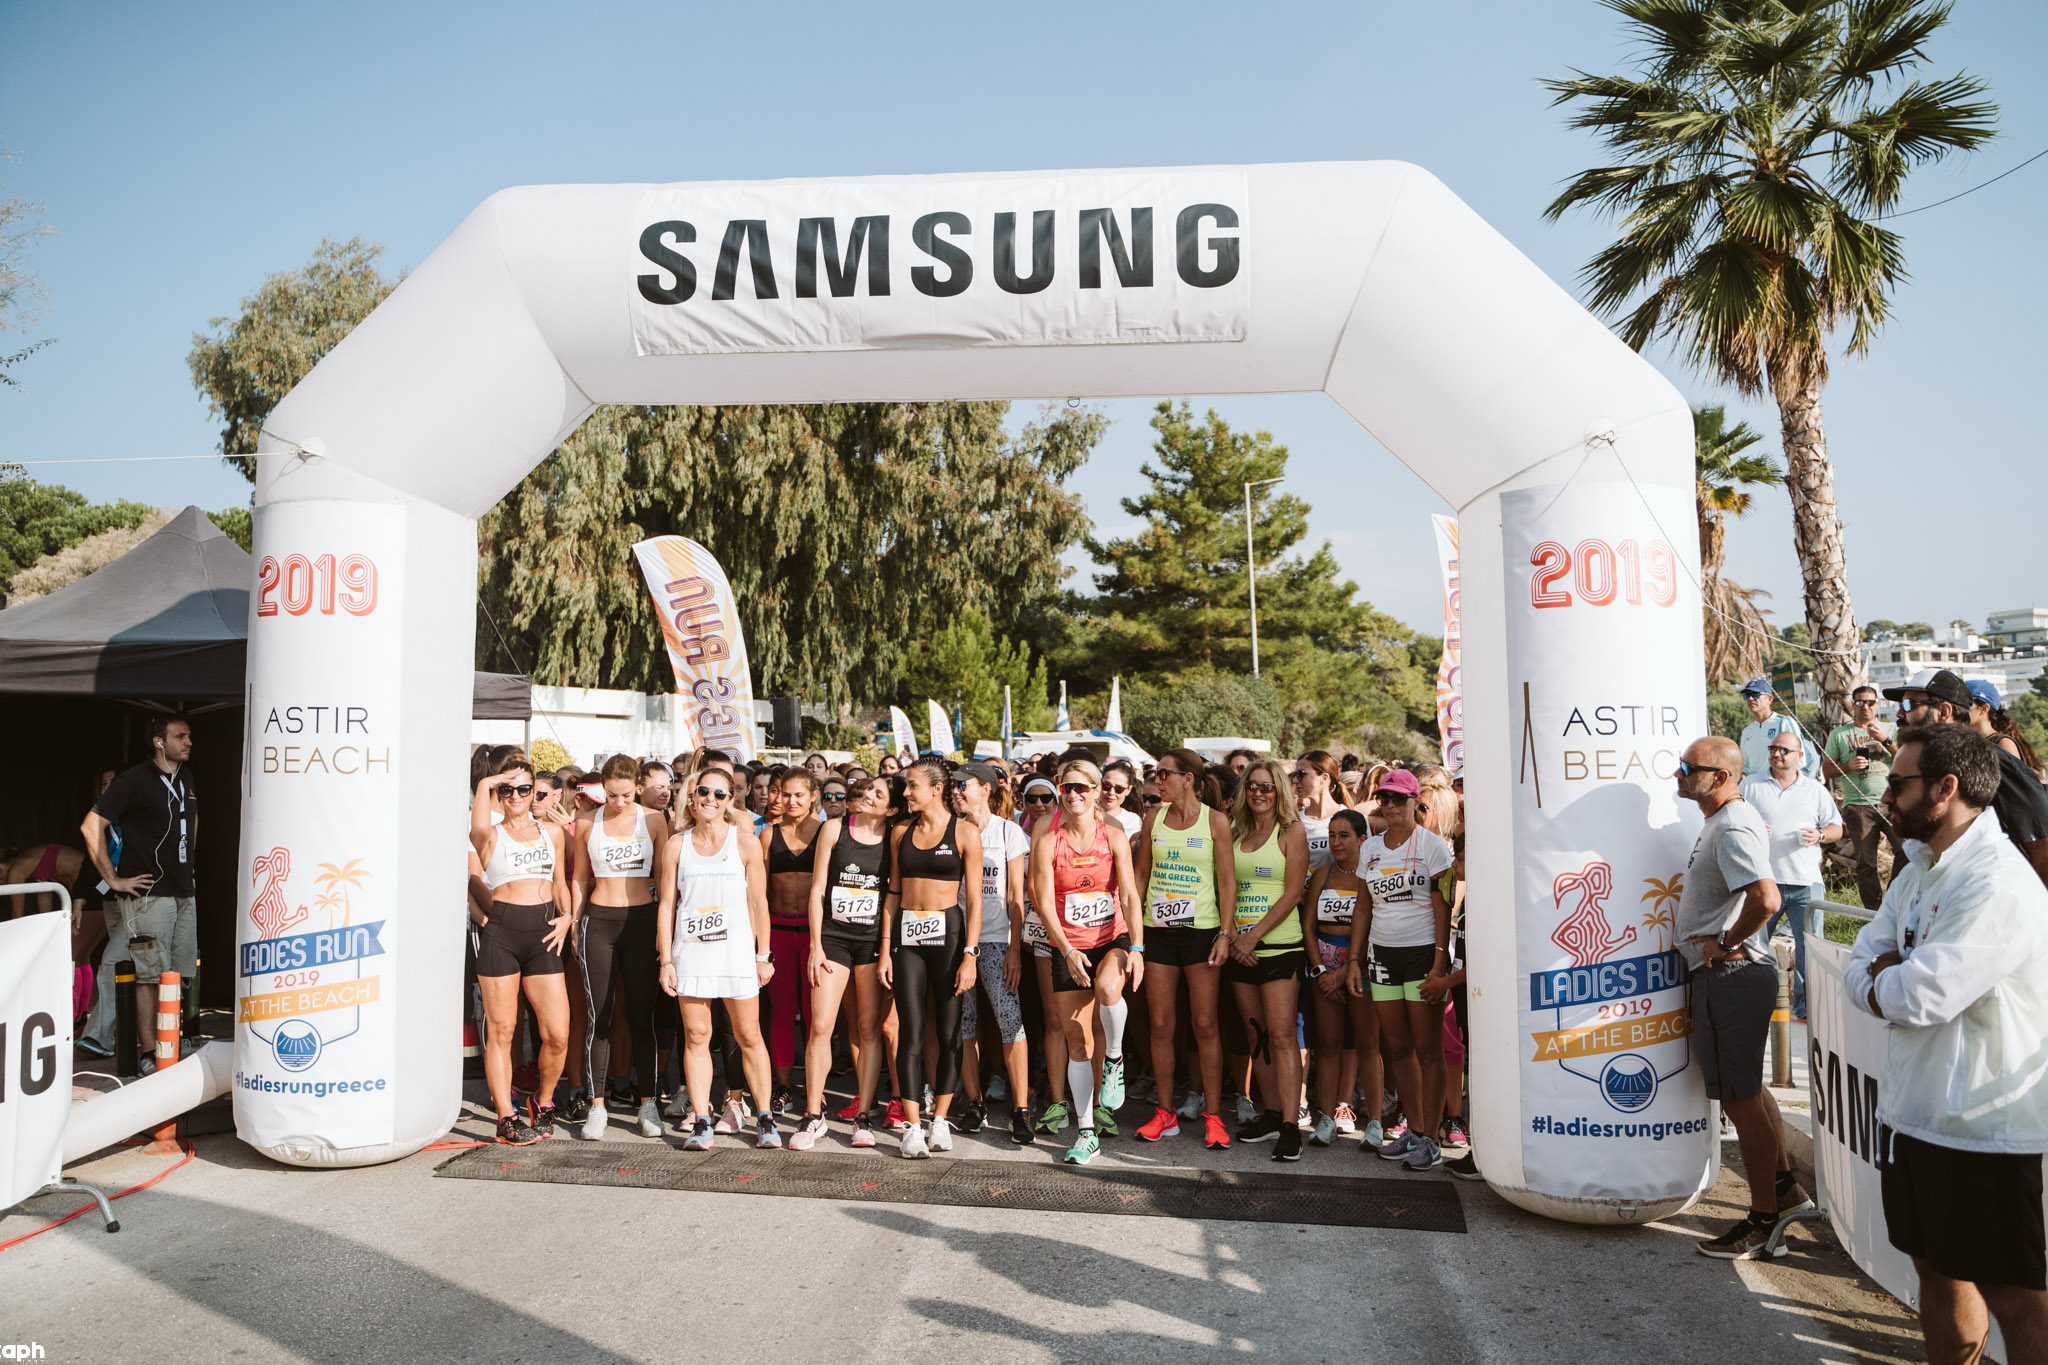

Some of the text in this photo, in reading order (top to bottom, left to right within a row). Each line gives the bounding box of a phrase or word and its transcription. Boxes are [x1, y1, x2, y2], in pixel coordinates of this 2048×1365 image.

[637, 203, 1240, 305] SAMSUNG
[257, 554, 379, 617] 2019
[1530, 538, 1677, 609] 2019
[664, 575, 731, 666] RUN
[264, 707, 369, 734] ASTIR
[1562, 705, 1680, 736] ASTIR
[263, 746, 390, 774] BEACH
[1563, 748, 1683, 781] BEAC
[514, 849, 549, 867] 5005
[605, 844, 642, 862] 5283
[840, 871, 866, 883] PROTEIN
[1152, 870, 1201, 883] TEAM GREECE
[1155, 862, 1197, 873] MARATHON
[1373, 875, 1403, 895] 5580
[836, 898, 874, 914] 5173
[1071, 899, 1109, 921] 5212
[1156, 901, 1190, 919] 5307
[687, 914, 723, 934] 5186
[907, 919, 940, 938] 5052
[243, 927, 370, 974] LADIES RUN
[273, 970, 320, 989] 2019
[1540, 962, 1638, 1006] LADIES
[243, 983, 371, 1018] AT THE BEACH
[1598, 998, 1652, 1020] 2019
[1545, 1034, 1573, 1055] AT
[1577, 1027, 1623, 1051] THE
[236, 1072, 387, 1098] #ladiesrungreece
[1532, 1114, 1708, 1142] #ladiesrungreece
